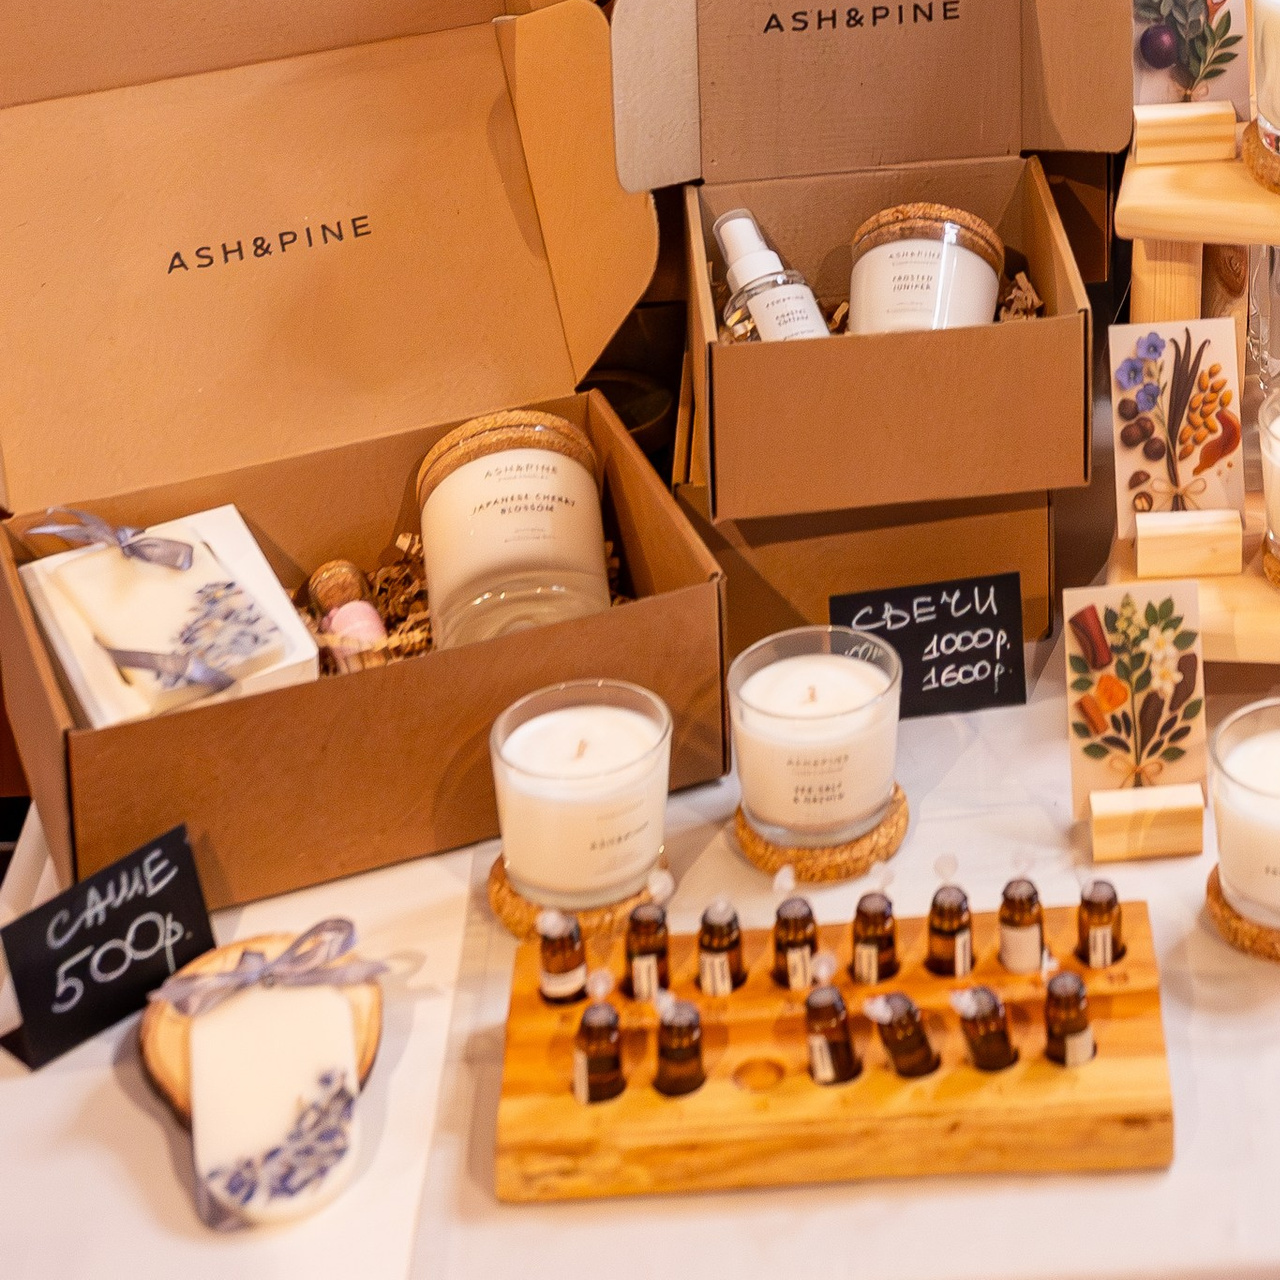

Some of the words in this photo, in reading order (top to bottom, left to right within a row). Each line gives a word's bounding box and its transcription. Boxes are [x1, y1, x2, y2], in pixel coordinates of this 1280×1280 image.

[762, 0, 962, 34] ASH&PINE
[166, 214, 373, 276] ASH&PINE
[851, 585, 999, 631] СВЕЧИ
[45, 847, 181, 951] САШЕ
